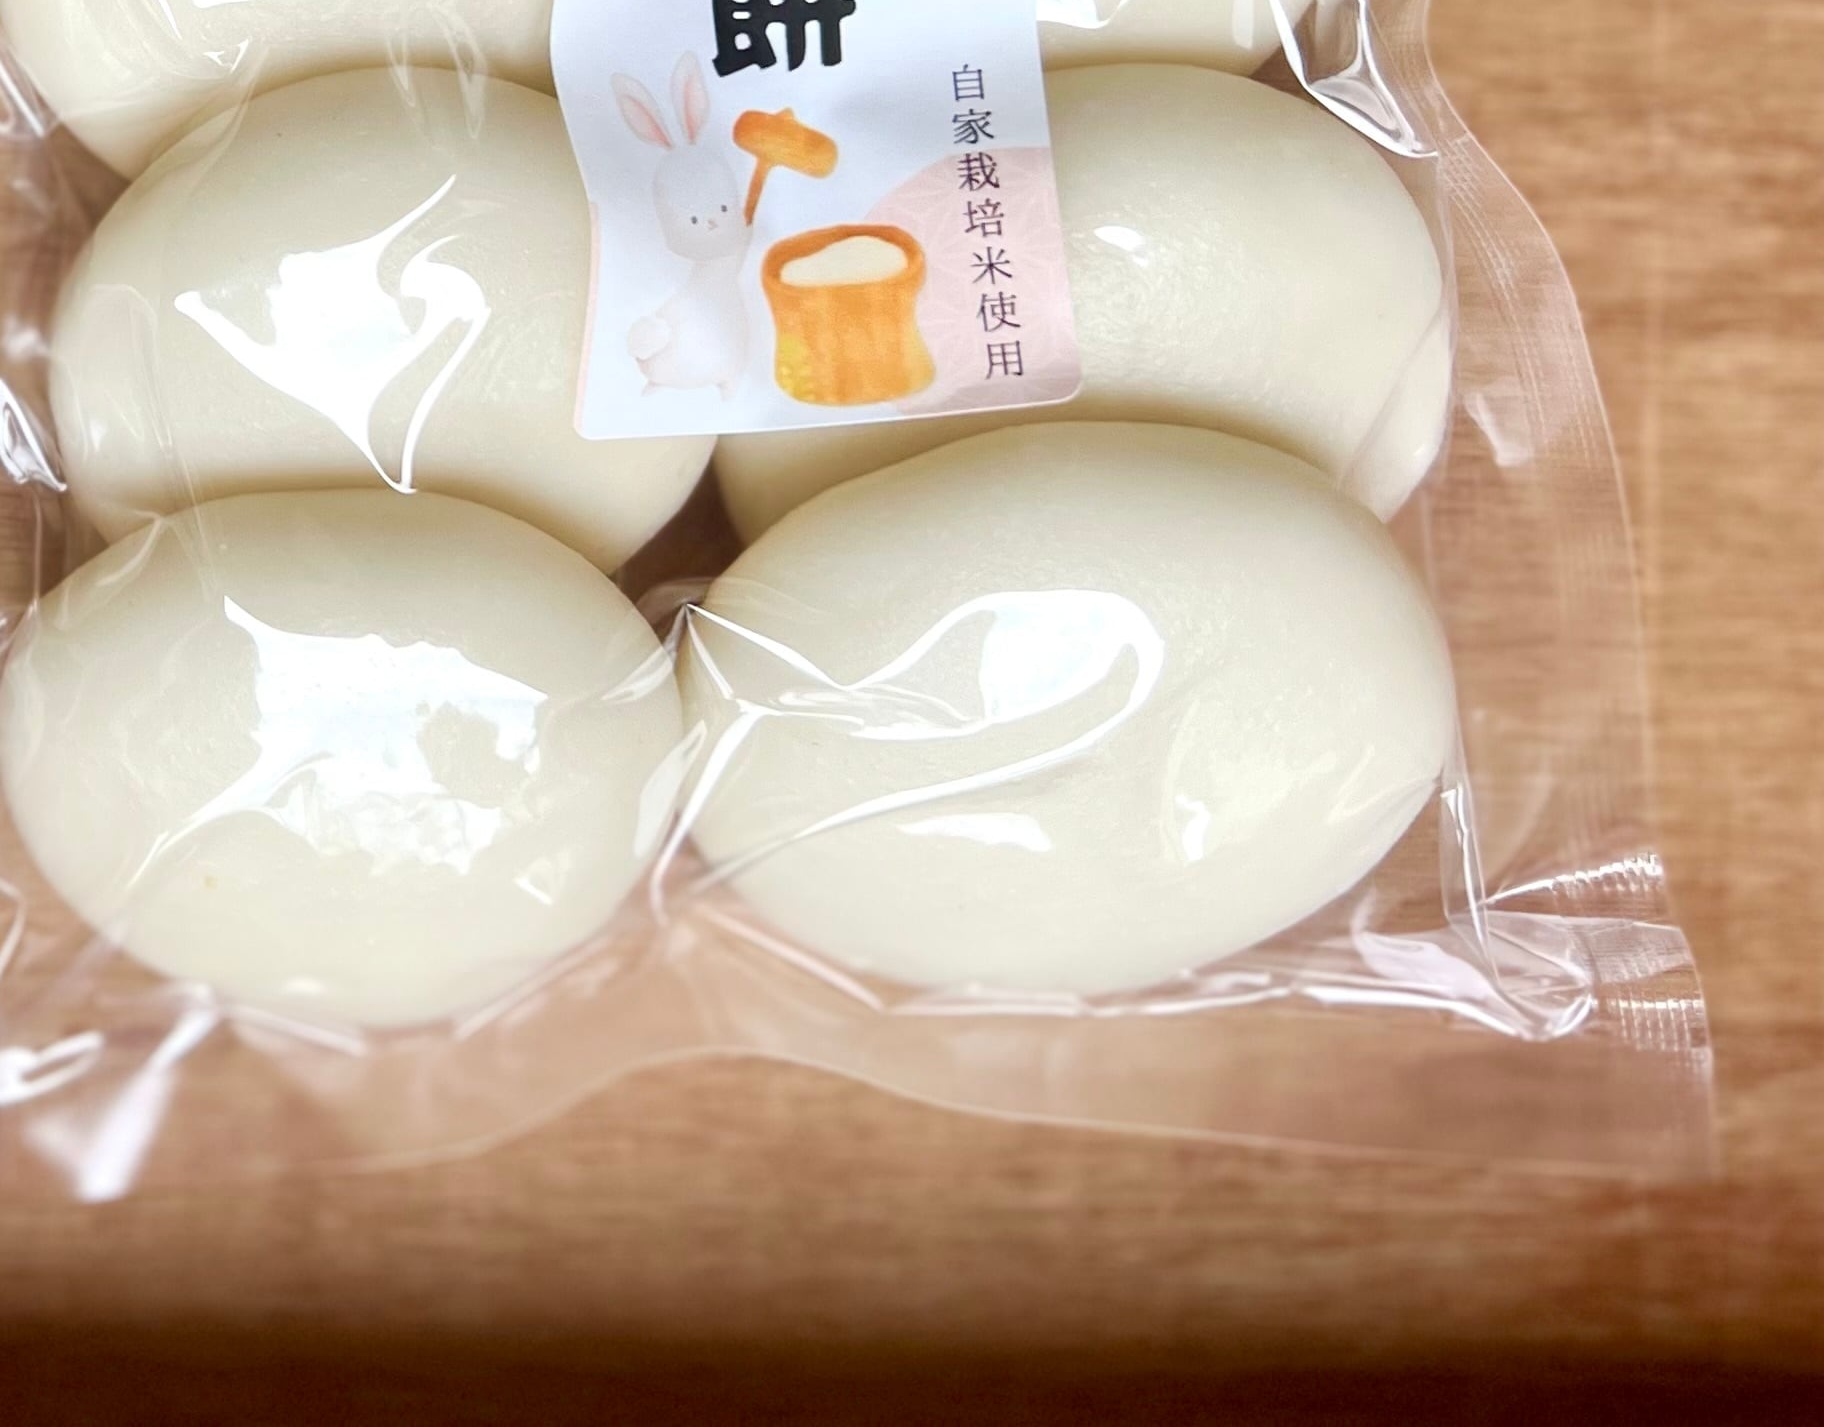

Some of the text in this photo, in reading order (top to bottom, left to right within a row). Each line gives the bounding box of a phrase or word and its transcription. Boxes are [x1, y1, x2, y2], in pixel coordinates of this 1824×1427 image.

[951, 64, 1024, 380] 自家栽培米使用
